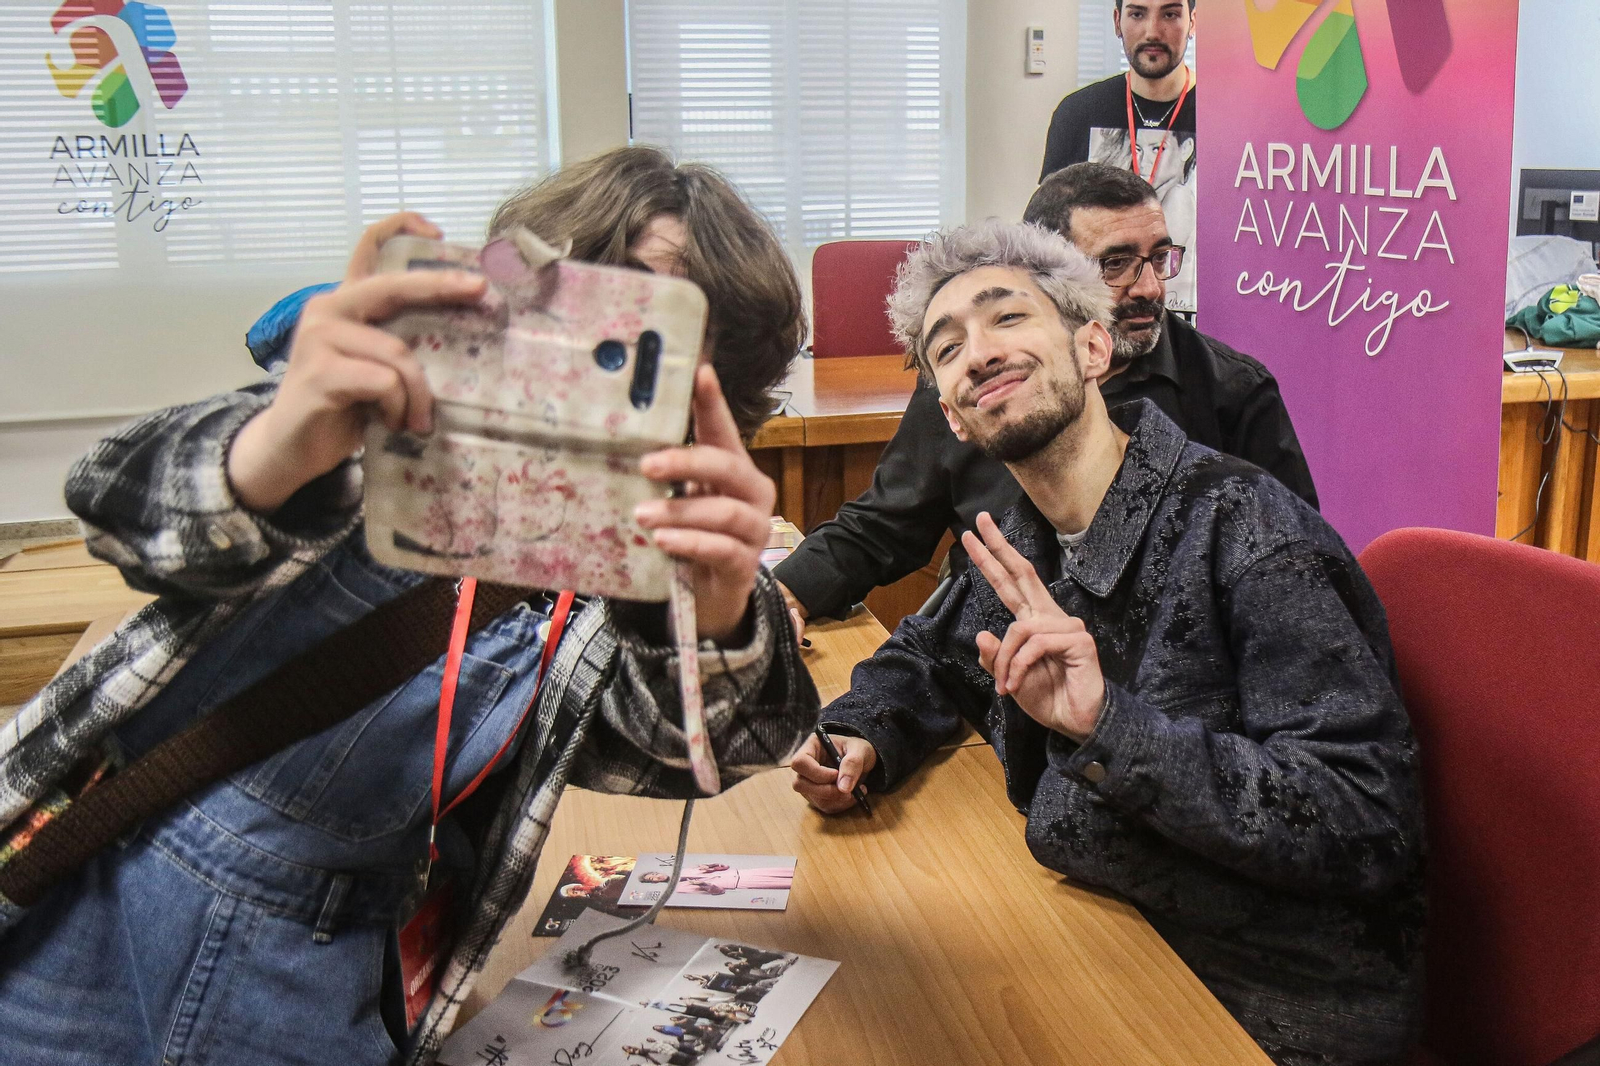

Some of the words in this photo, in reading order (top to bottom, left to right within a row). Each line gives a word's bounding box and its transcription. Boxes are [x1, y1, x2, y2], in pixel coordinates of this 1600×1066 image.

[49, 132, 201, 160] ARMILLA
[1234, 141, 1457, 201] ARMILLA
[52, 160, 203, 188] AVANZA
[57, 179, 204, 233] contigo
[1233, 197, 1455, 265] AVANZA
[1236, 239, 1450, 357] contigo
[581, 964, 621, 994] 2023
